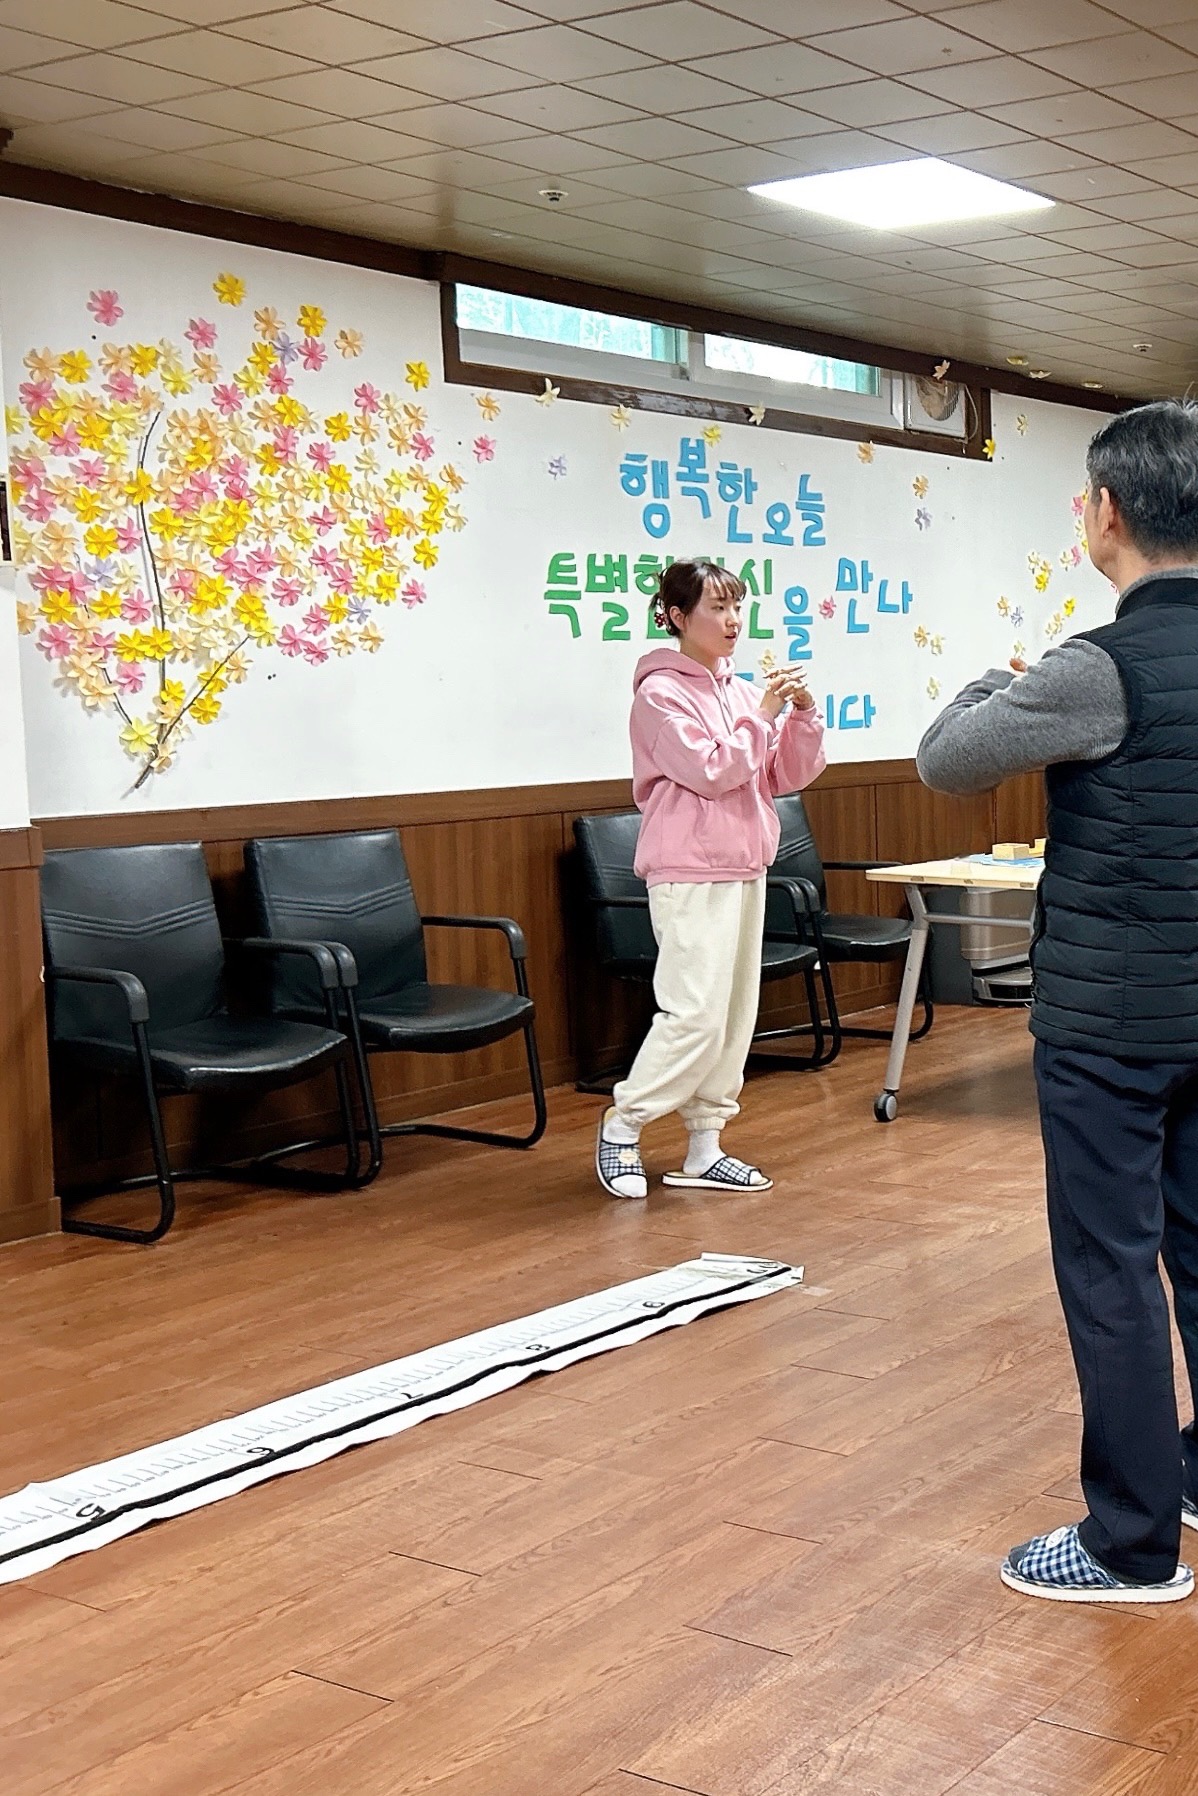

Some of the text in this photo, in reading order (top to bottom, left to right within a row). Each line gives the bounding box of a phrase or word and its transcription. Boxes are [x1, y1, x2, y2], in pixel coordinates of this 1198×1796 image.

[693, 556, 813, 661] 신을
[836, 557, 913, 634] 만나
[75, 1503, 107, 1522] 5
